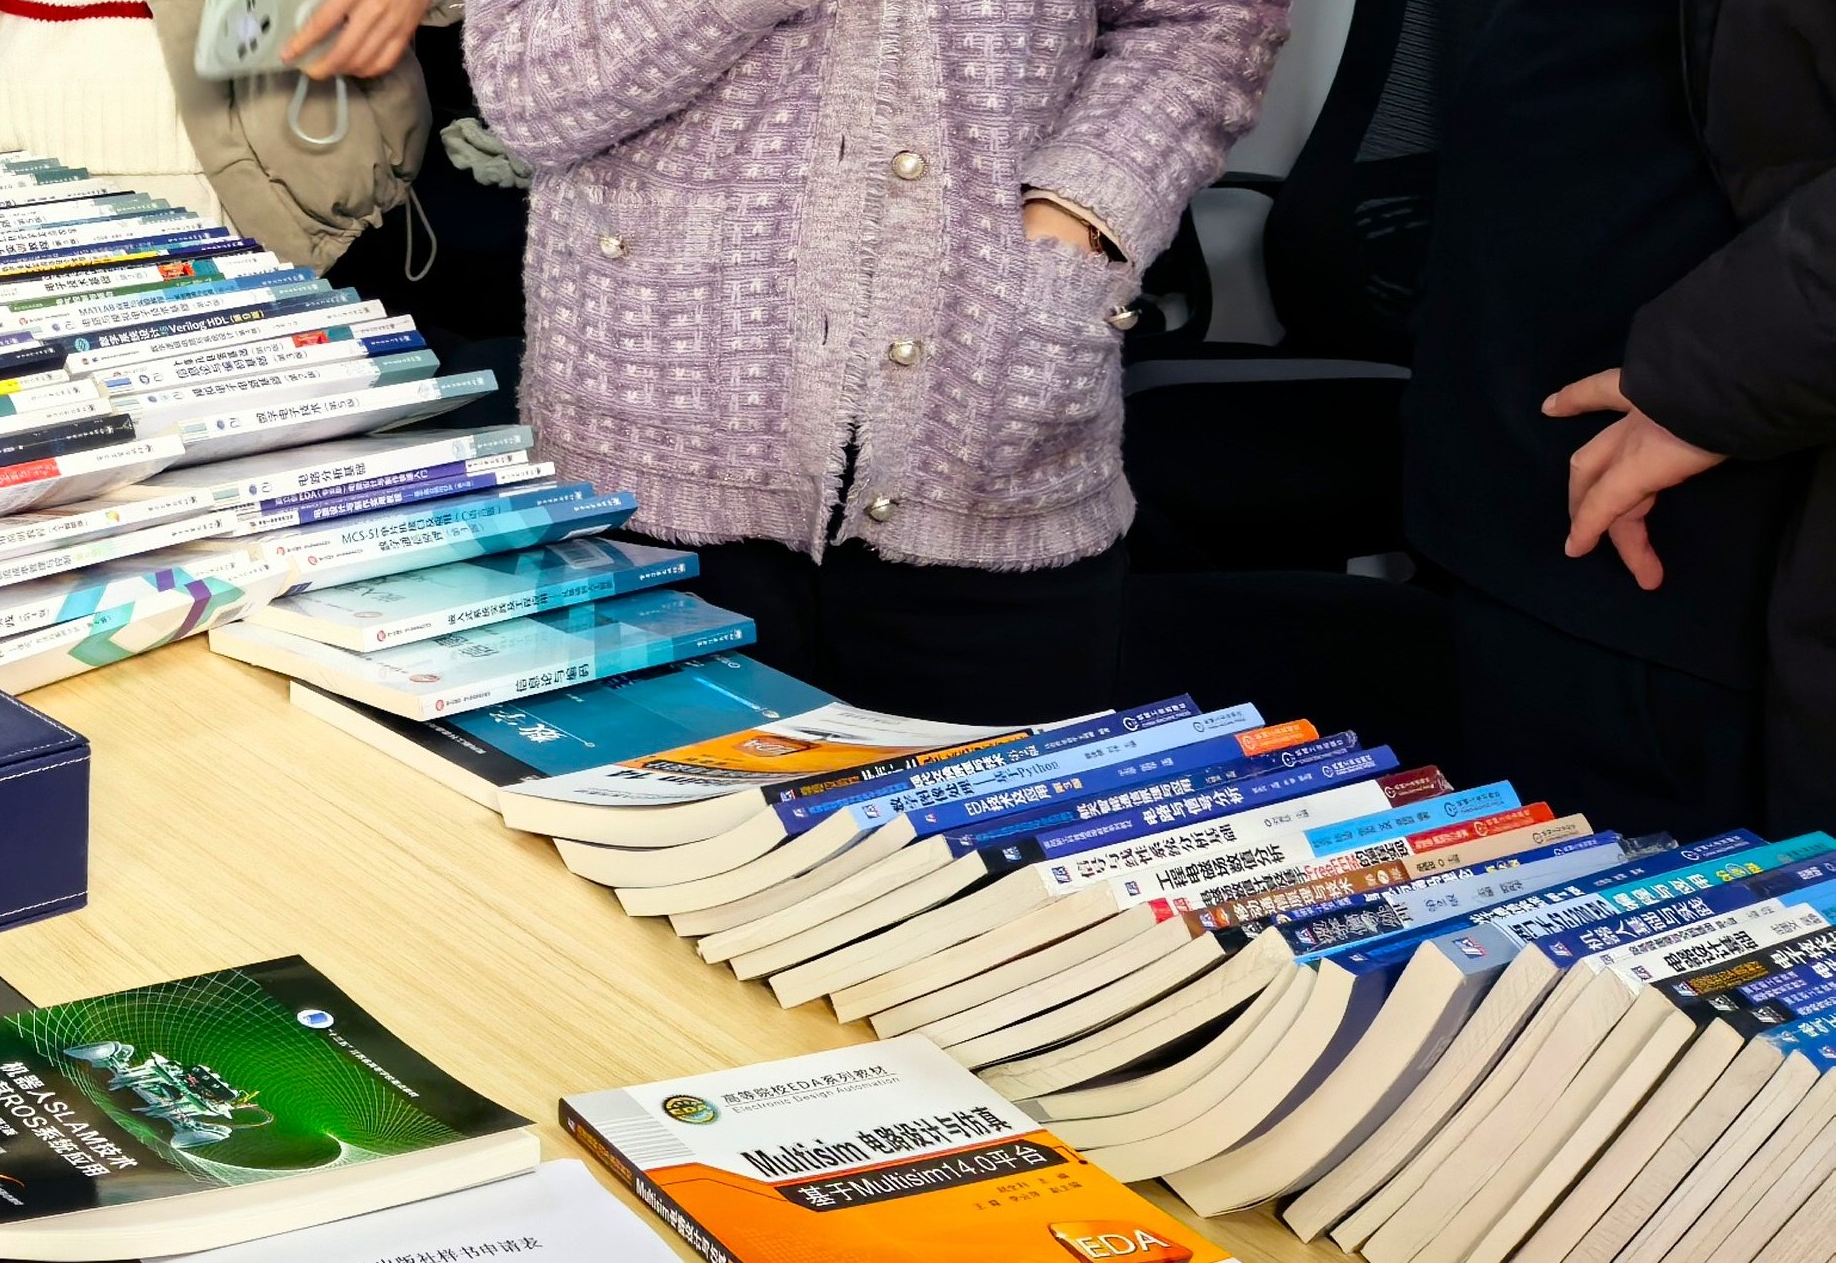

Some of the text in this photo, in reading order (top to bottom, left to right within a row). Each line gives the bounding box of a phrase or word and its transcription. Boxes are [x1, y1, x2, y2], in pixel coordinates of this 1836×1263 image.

[1142, 788, 1246, 827] 电路与信号分析
[1155, 844, 1287, 891] 工程电磁场数值分析
[0, 1059, 139, 1171] 机器人SLAM技术
[739, 1106, 1013, 1179] Multisim 电路设计与仿真
[797, 1143, 1048, 1208] 基于Multisim14.0平台
[1070, 1226, 1171, 1261] EDA
